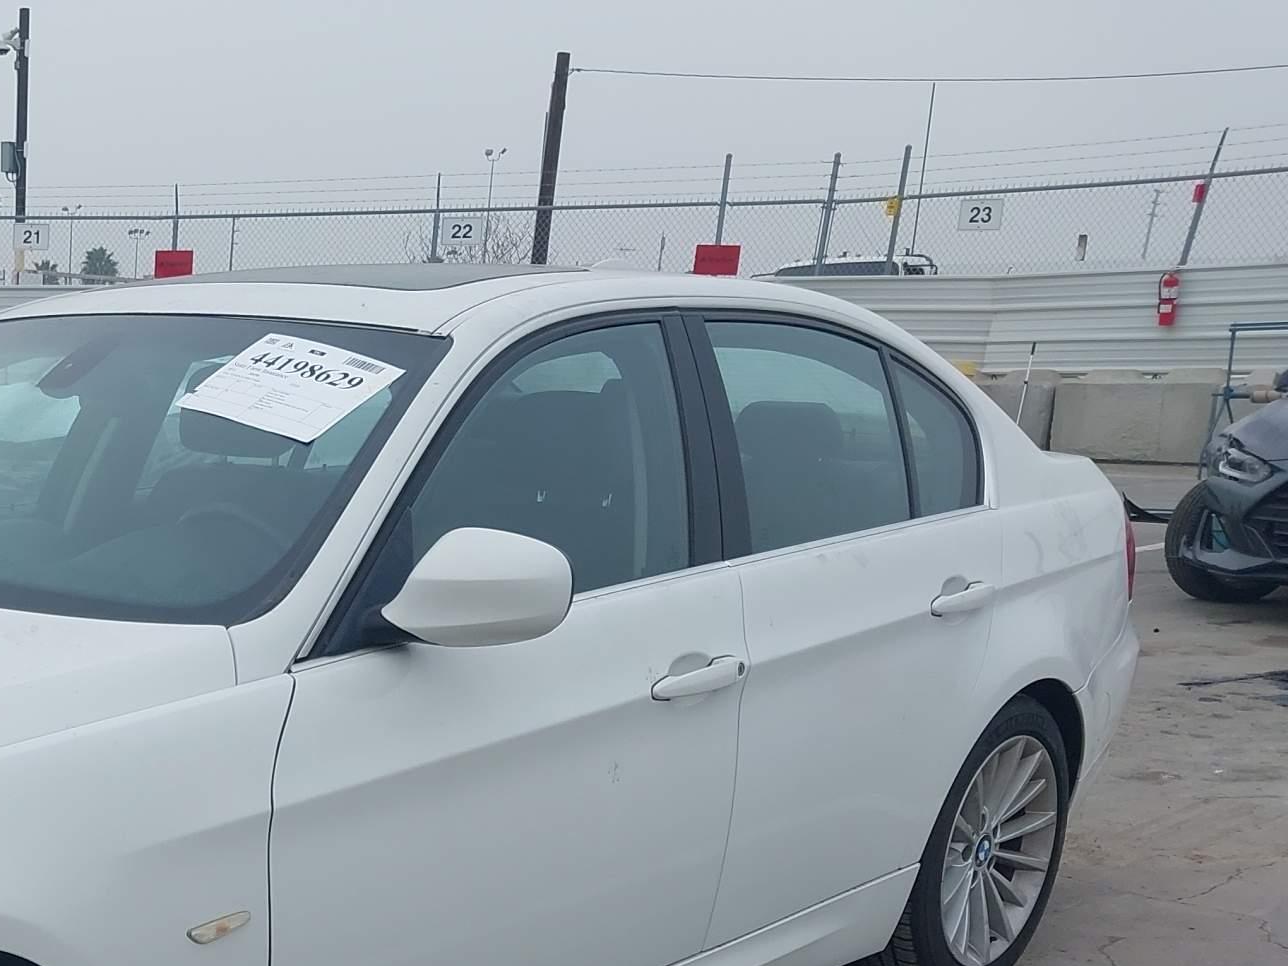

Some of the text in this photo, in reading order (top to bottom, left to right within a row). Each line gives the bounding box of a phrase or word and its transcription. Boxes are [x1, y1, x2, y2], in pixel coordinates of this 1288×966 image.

[969, 206, 992, 223] 23
[22, 229, 40, 244] 21
[451, 223, 472, 239] 22
[249, 352, 364, 389] 44198629
